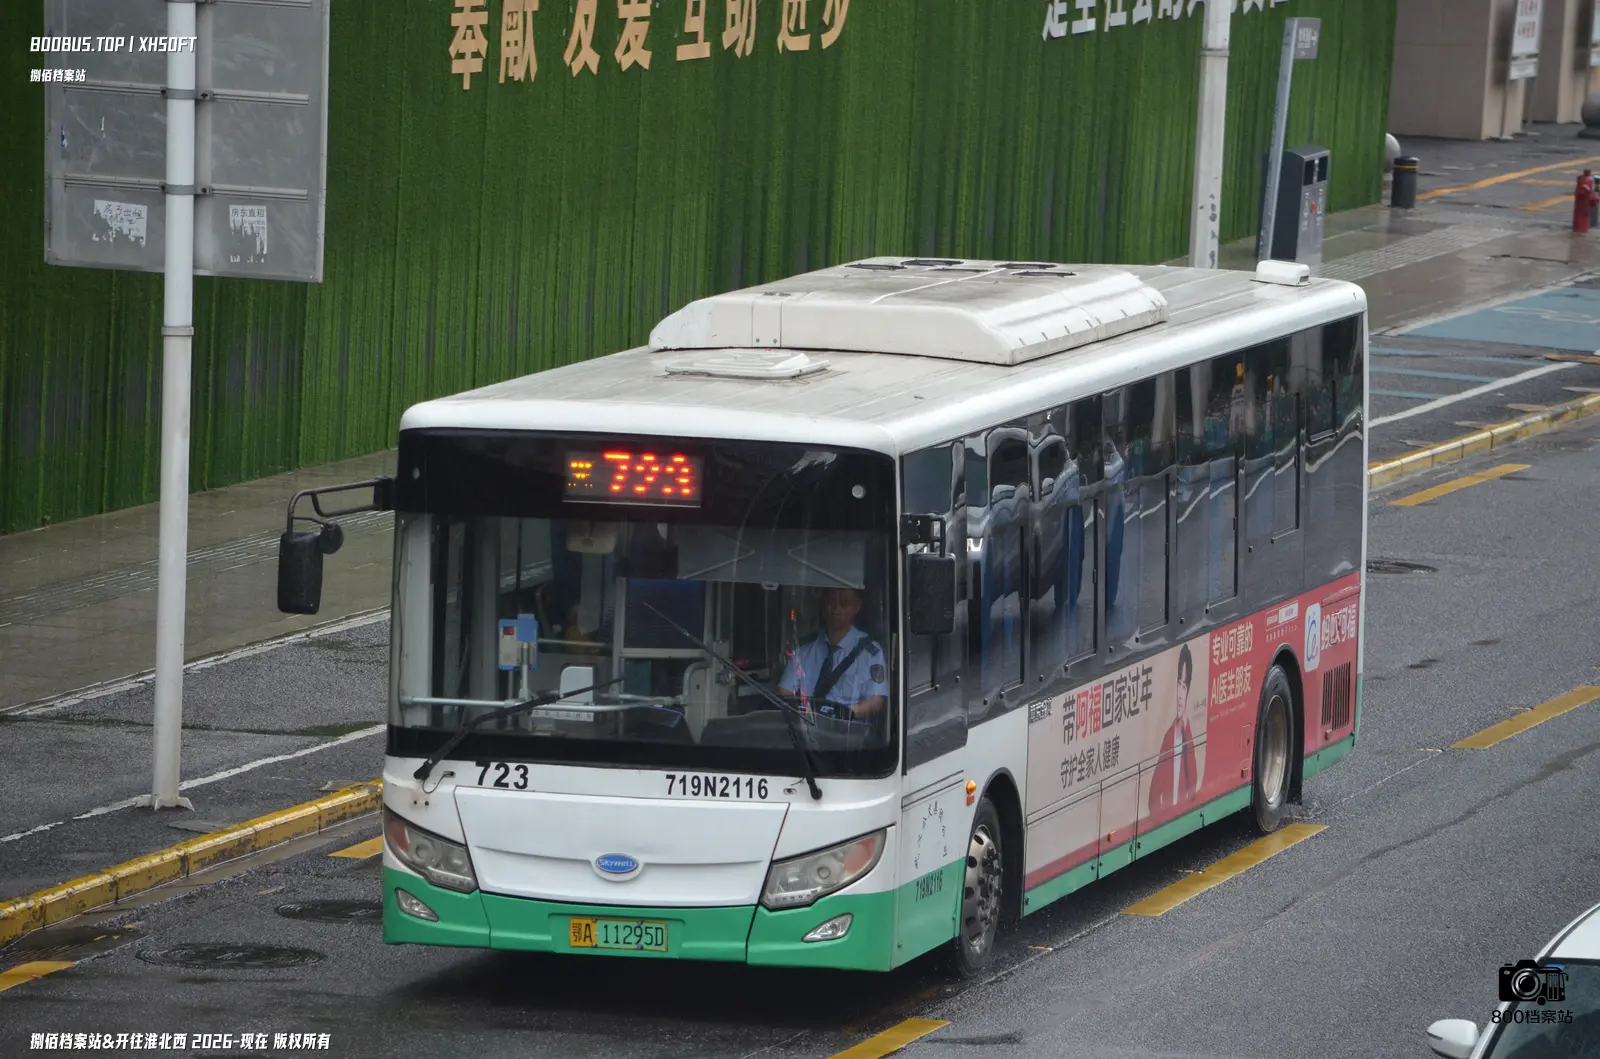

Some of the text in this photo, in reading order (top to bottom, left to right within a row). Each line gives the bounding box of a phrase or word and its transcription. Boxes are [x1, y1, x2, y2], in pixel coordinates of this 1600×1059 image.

[1212, 621, 1253, 665] 专业可靠的
[1062, 664, 1153, 745] 带阿福回家过年
[1211, 662, 1252, 706] AI医生朋友
[475, 761, 529, 789] 723
[1061, 734, 1120, 789] 守护全家人健康
[666, 774, 768, 799] 719N2116
[603, 924, 665, 947] 11295D
